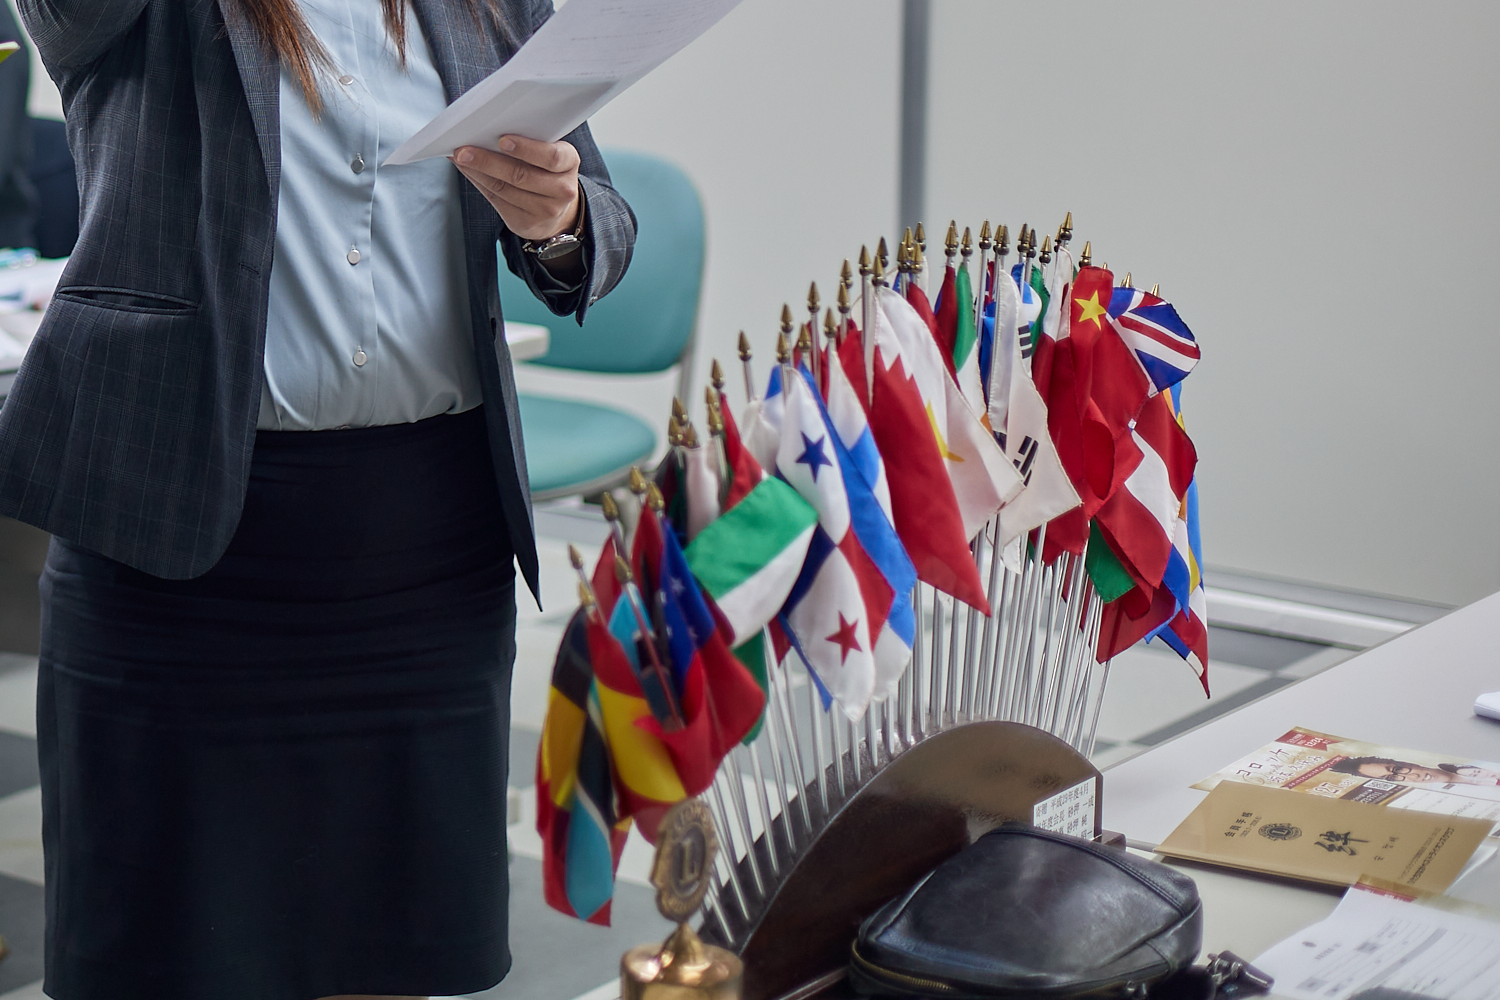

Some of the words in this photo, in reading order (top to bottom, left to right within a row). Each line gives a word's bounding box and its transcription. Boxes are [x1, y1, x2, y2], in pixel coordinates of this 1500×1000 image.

[1236, 748, 1290, 776] コロッケ
[1313, 830, 1370, 857] 絆
